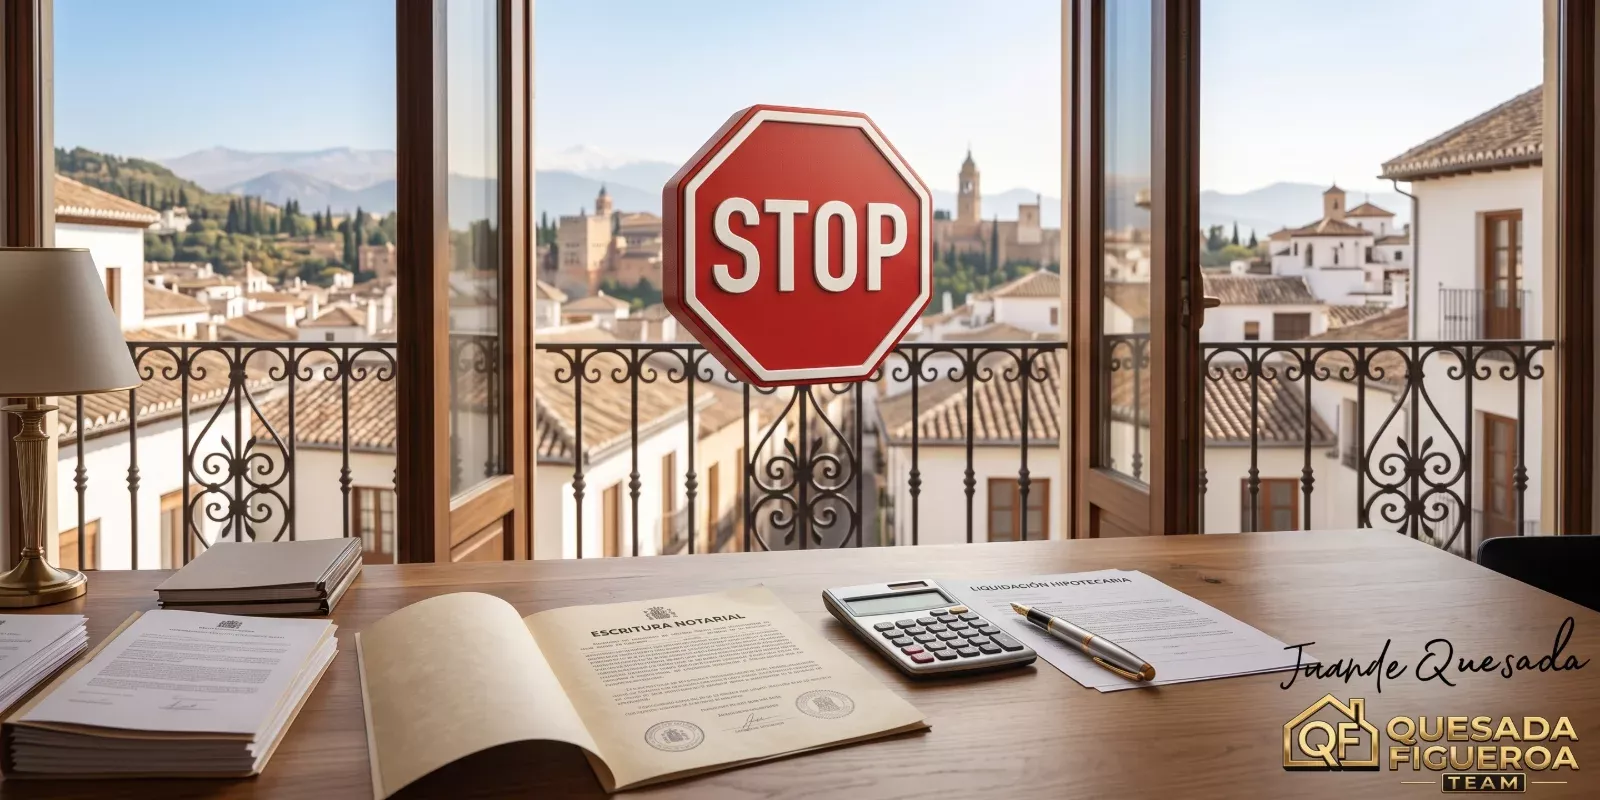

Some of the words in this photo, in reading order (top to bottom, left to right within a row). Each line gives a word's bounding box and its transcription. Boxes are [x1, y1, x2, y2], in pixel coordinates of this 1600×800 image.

[712, 197, 908, 293] STOP
[970, 581, 1049, 592] LIQUIDACIÓN
[1050, 577, 1132, 587] HIPOTECARIA
[590, 622, 673, 638] ESCRITURA
[674, 613, 747, 628] NOTARIAL
